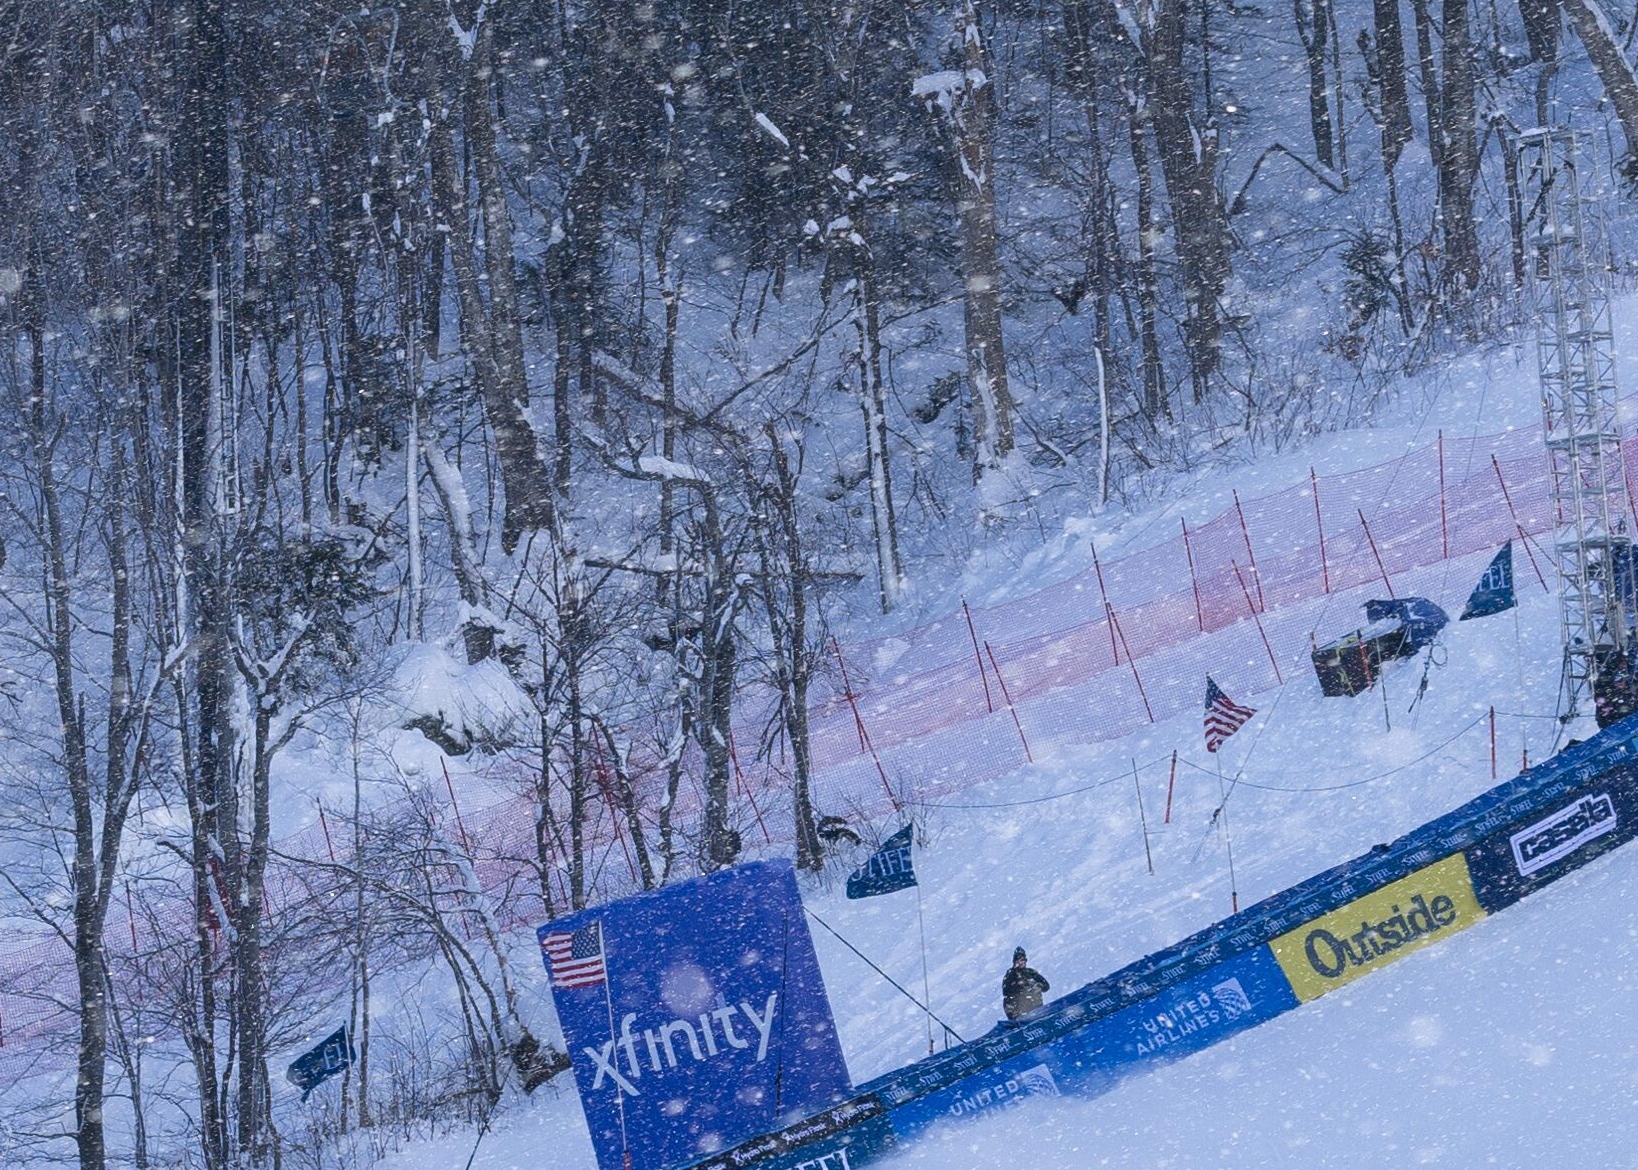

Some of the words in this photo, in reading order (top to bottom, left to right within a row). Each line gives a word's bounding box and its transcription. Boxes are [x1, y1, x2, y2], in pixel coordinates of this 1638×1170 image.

[1304, 891, 1457, 979] Outside
[1137, 1008, 1220, 1057] AIRLINES
[1143, 992, 1212, 1033] UNITED
[584, 990, 779, 1097] xfinity
[950, 1080, 1020, 1117] UNITED
